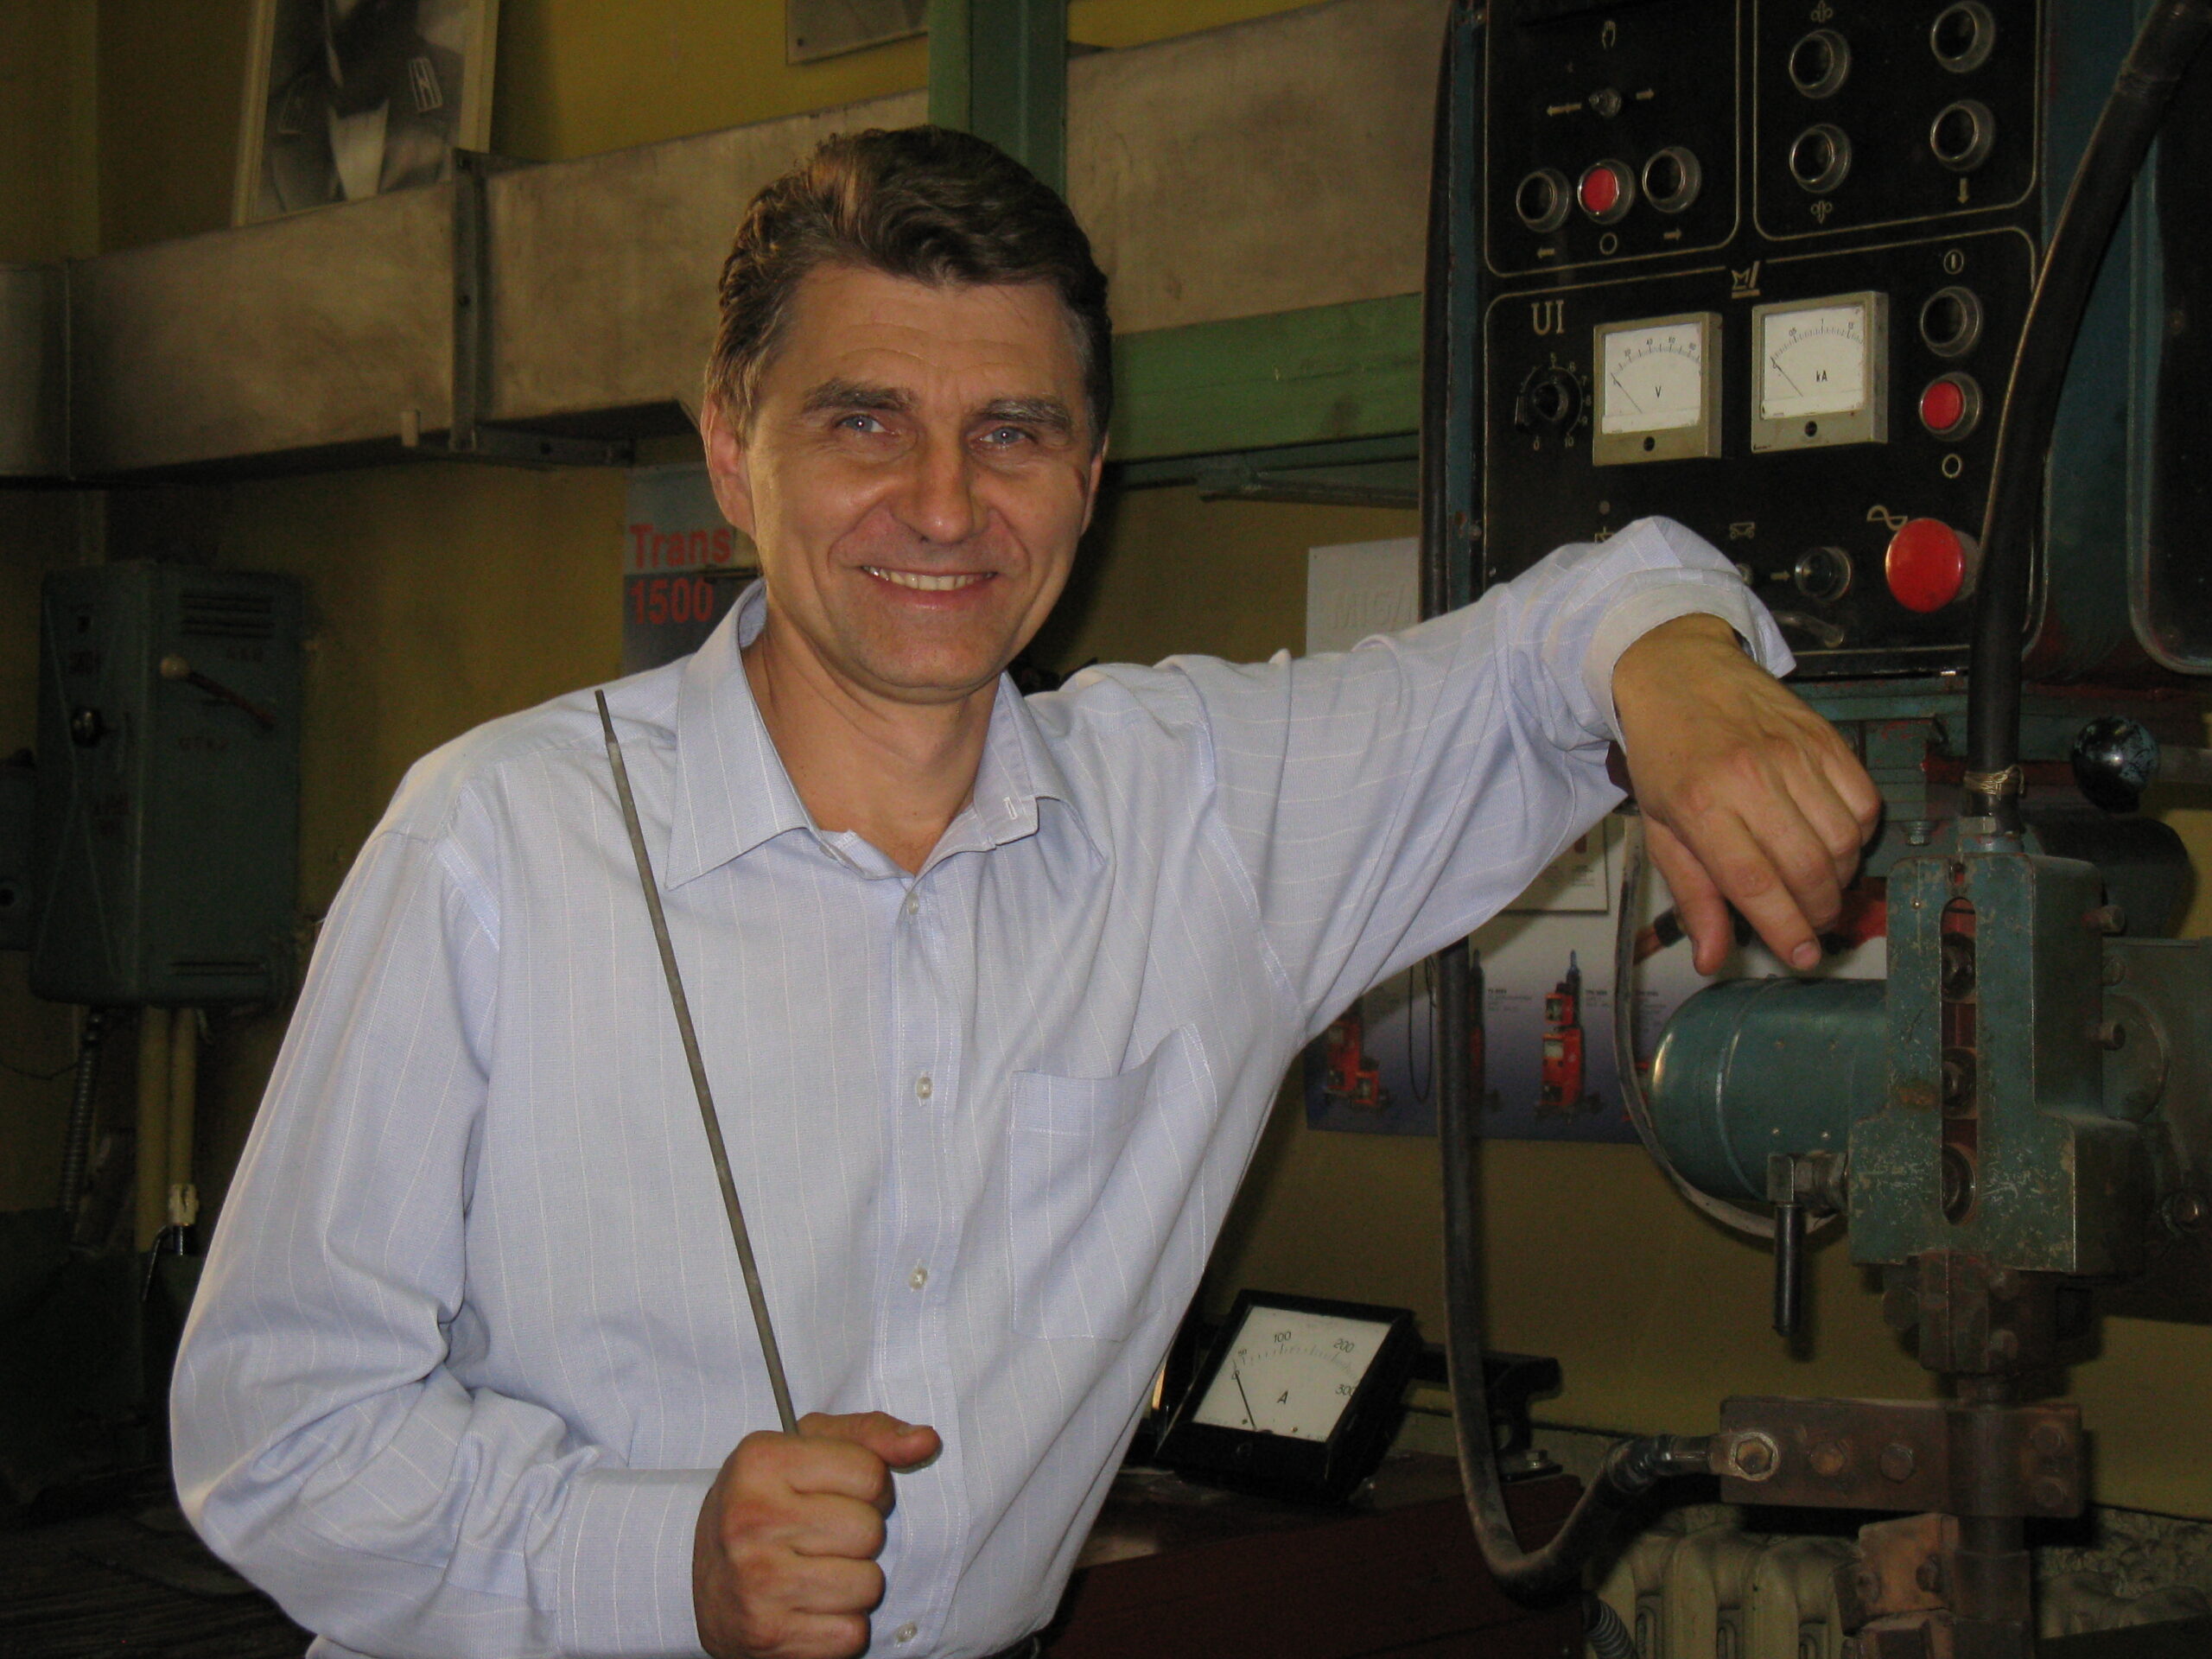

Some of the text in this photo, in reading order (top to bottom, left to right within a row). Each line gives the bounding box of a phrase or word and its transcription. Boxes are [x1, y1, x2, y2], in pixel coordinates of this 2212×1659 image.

[1531, 300, 1565, 335] UI
[1816, 370, 1828, 383] kA
[1655, 386, 1662, 398] V
[629, 524, 733, 569] Trans
[629, 576, 715, 625] 1500
[1274, 1331, 1292, 1344] 100
[1333, 1338, 1355, 1353] 200
[1276, 1389, 1288, 1404] A
